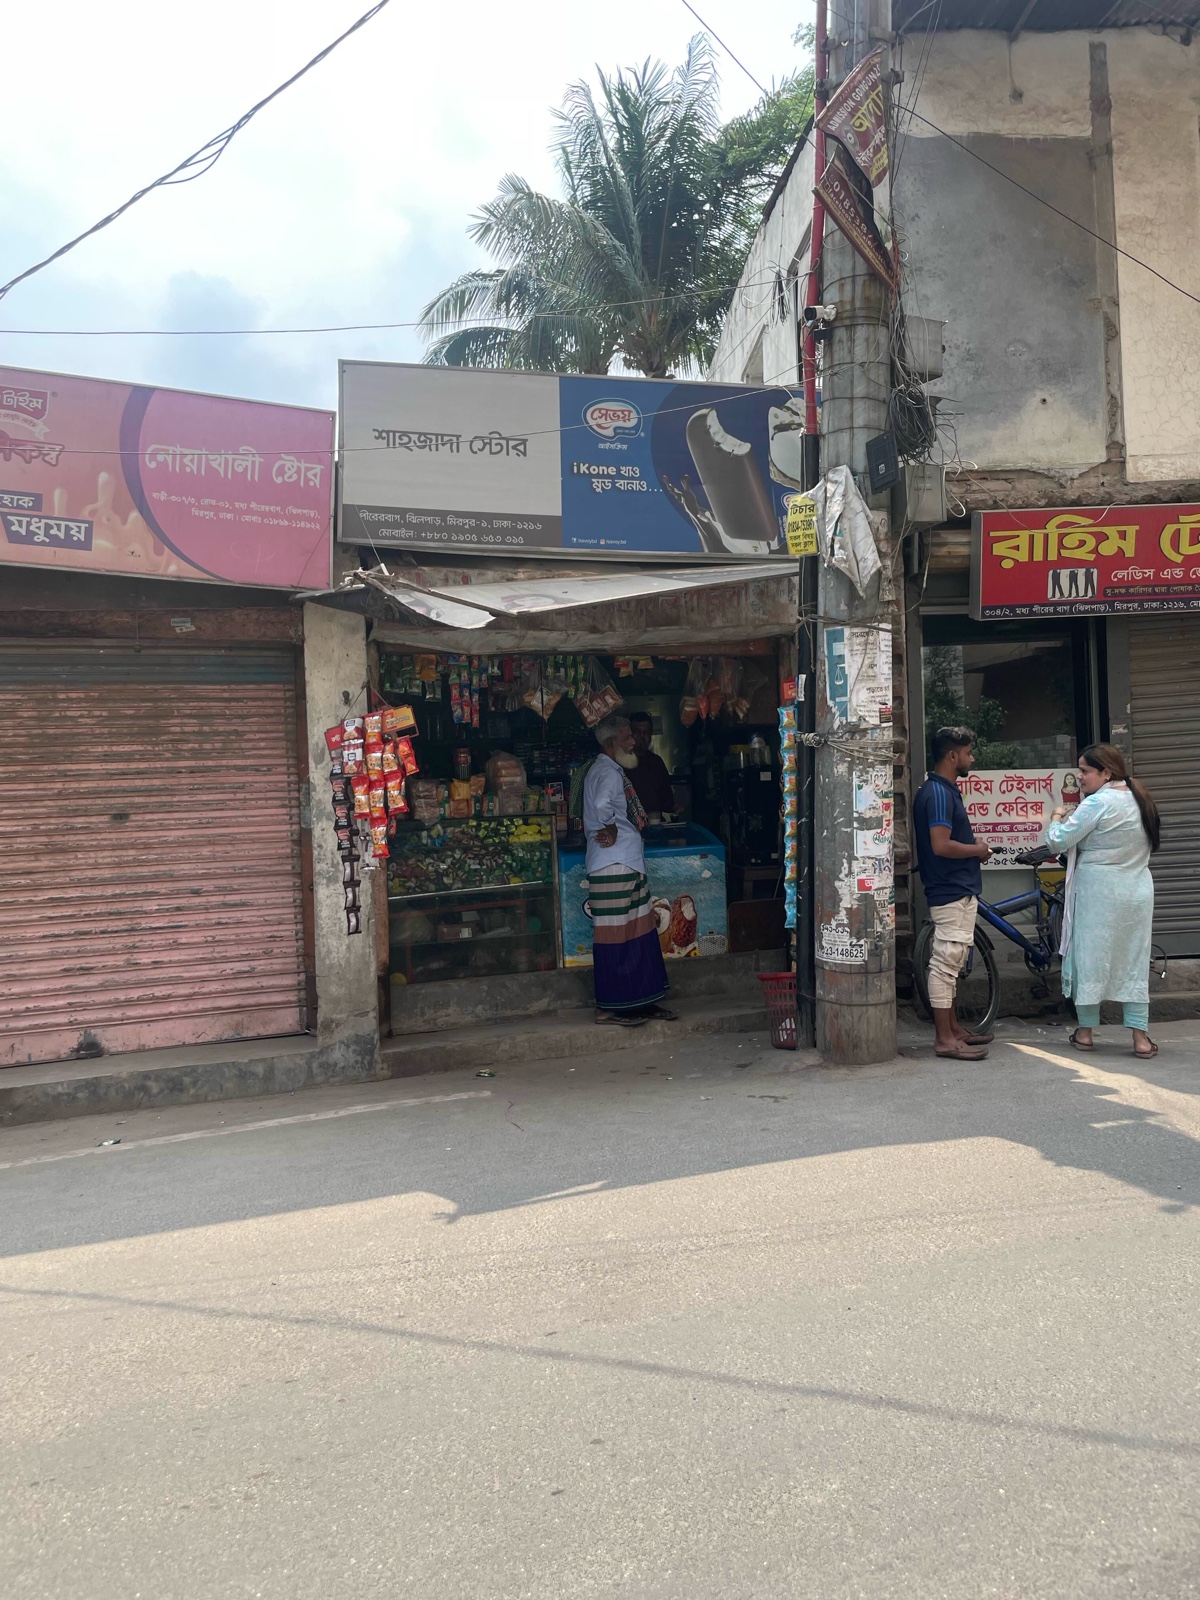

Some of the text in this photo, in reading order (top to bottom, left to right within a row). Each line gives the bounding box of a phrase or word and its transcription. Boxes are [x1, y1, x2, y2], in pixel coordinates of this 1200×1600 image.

[827, 98, 856, 132] ADMISSION
[590, 407, 633, 423] সেভয়
[372, 428, 528, 457] শাহজাদা স্টোর
[145, 444, 264, 483] নোয়াখালী
[620, 466, 640, 477] খাও
[591, 478, 612, 493] মুড
[7, 515, 89, 543] মধুময়
[360, 509, 542, 530] পীরেরবাগ, ঝিলপাড়, মিরপুর-১, ঢাকা-১২১৬
[379, 528, 417, 538] মোবাইল:
[421, 531, 448, 539] +৮৮০
[989, 514, 1140, 569] রাহিম
[1111, 566, 1156, 582] লেডিস
[1160, 567, 1185, 579] এন্ড
[1114, 602, 1141, 611] মিরপুর,
[999, 772, 1054, 794] টেইলার্স
